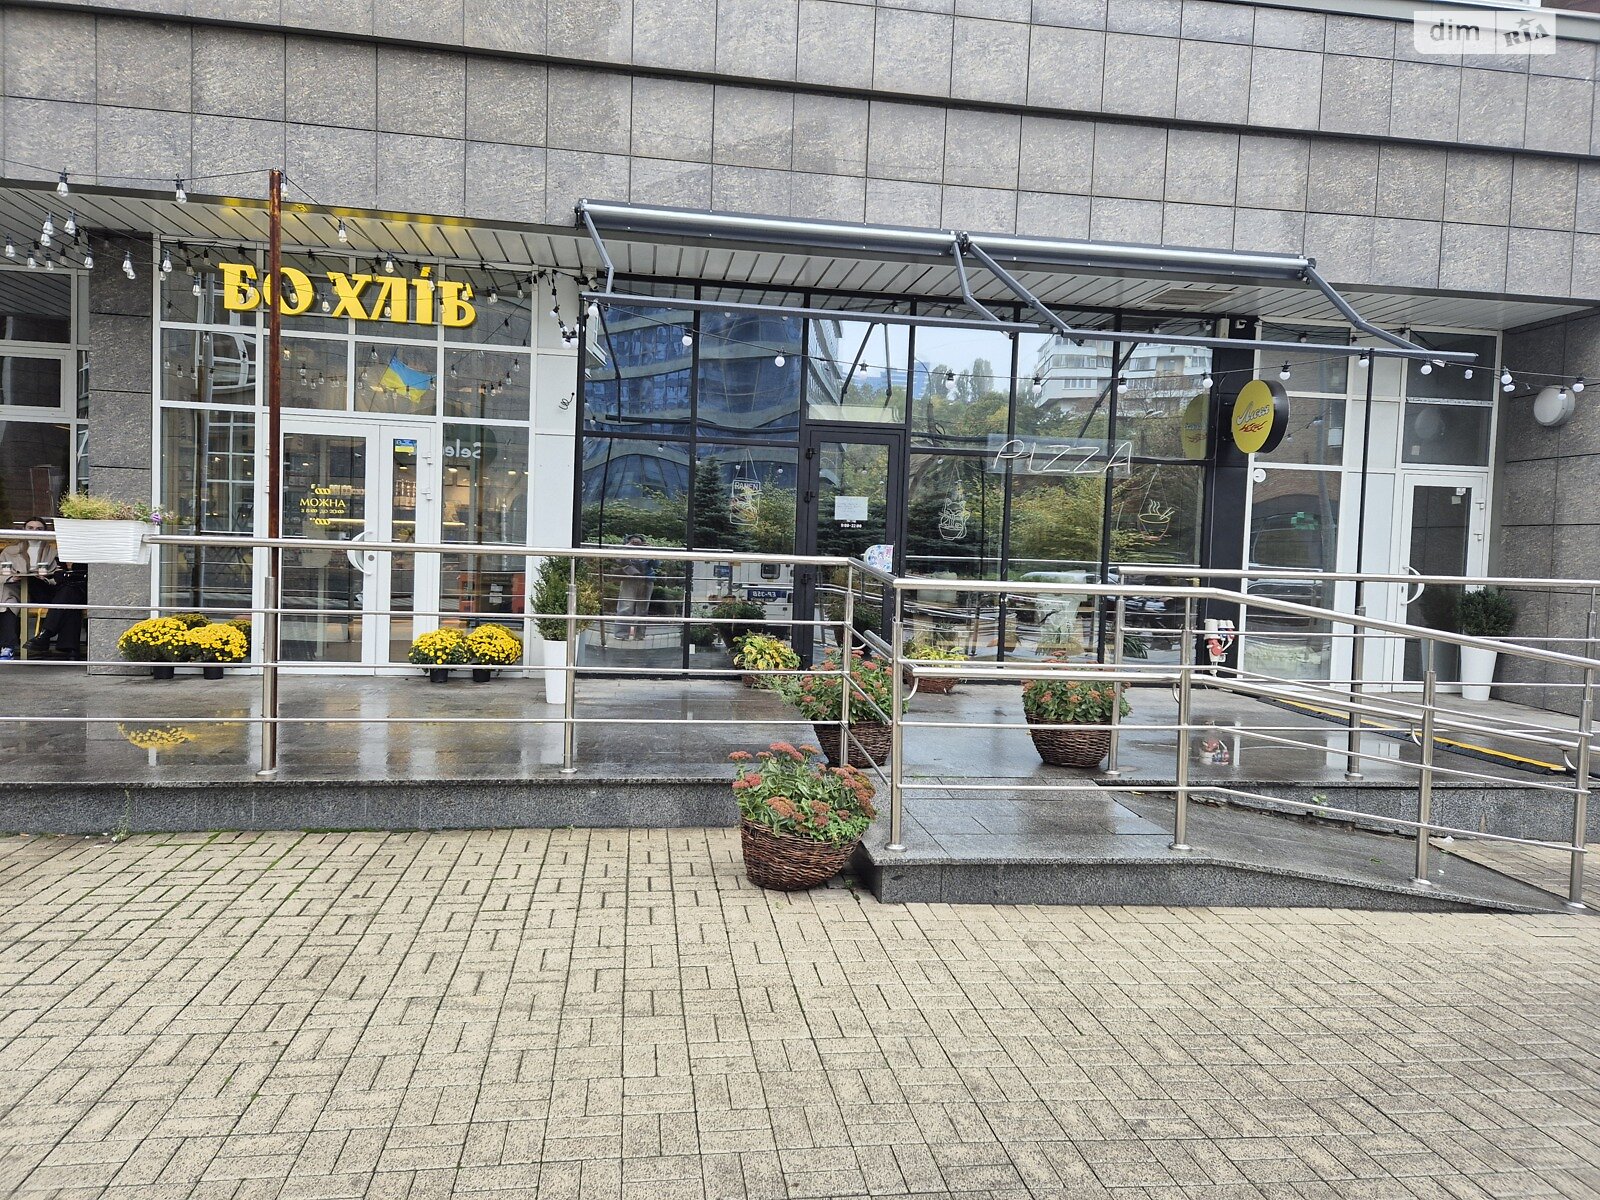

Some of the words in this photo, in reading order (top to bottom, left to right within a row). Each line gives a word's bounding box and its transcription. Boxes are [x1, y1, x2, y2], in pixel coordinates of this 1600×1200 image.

[327, 264, 477, 328] ХЛІБ
[993, 439, 1133, 475] PIZZA
[299, 498, 346, 507] МОЖНА
